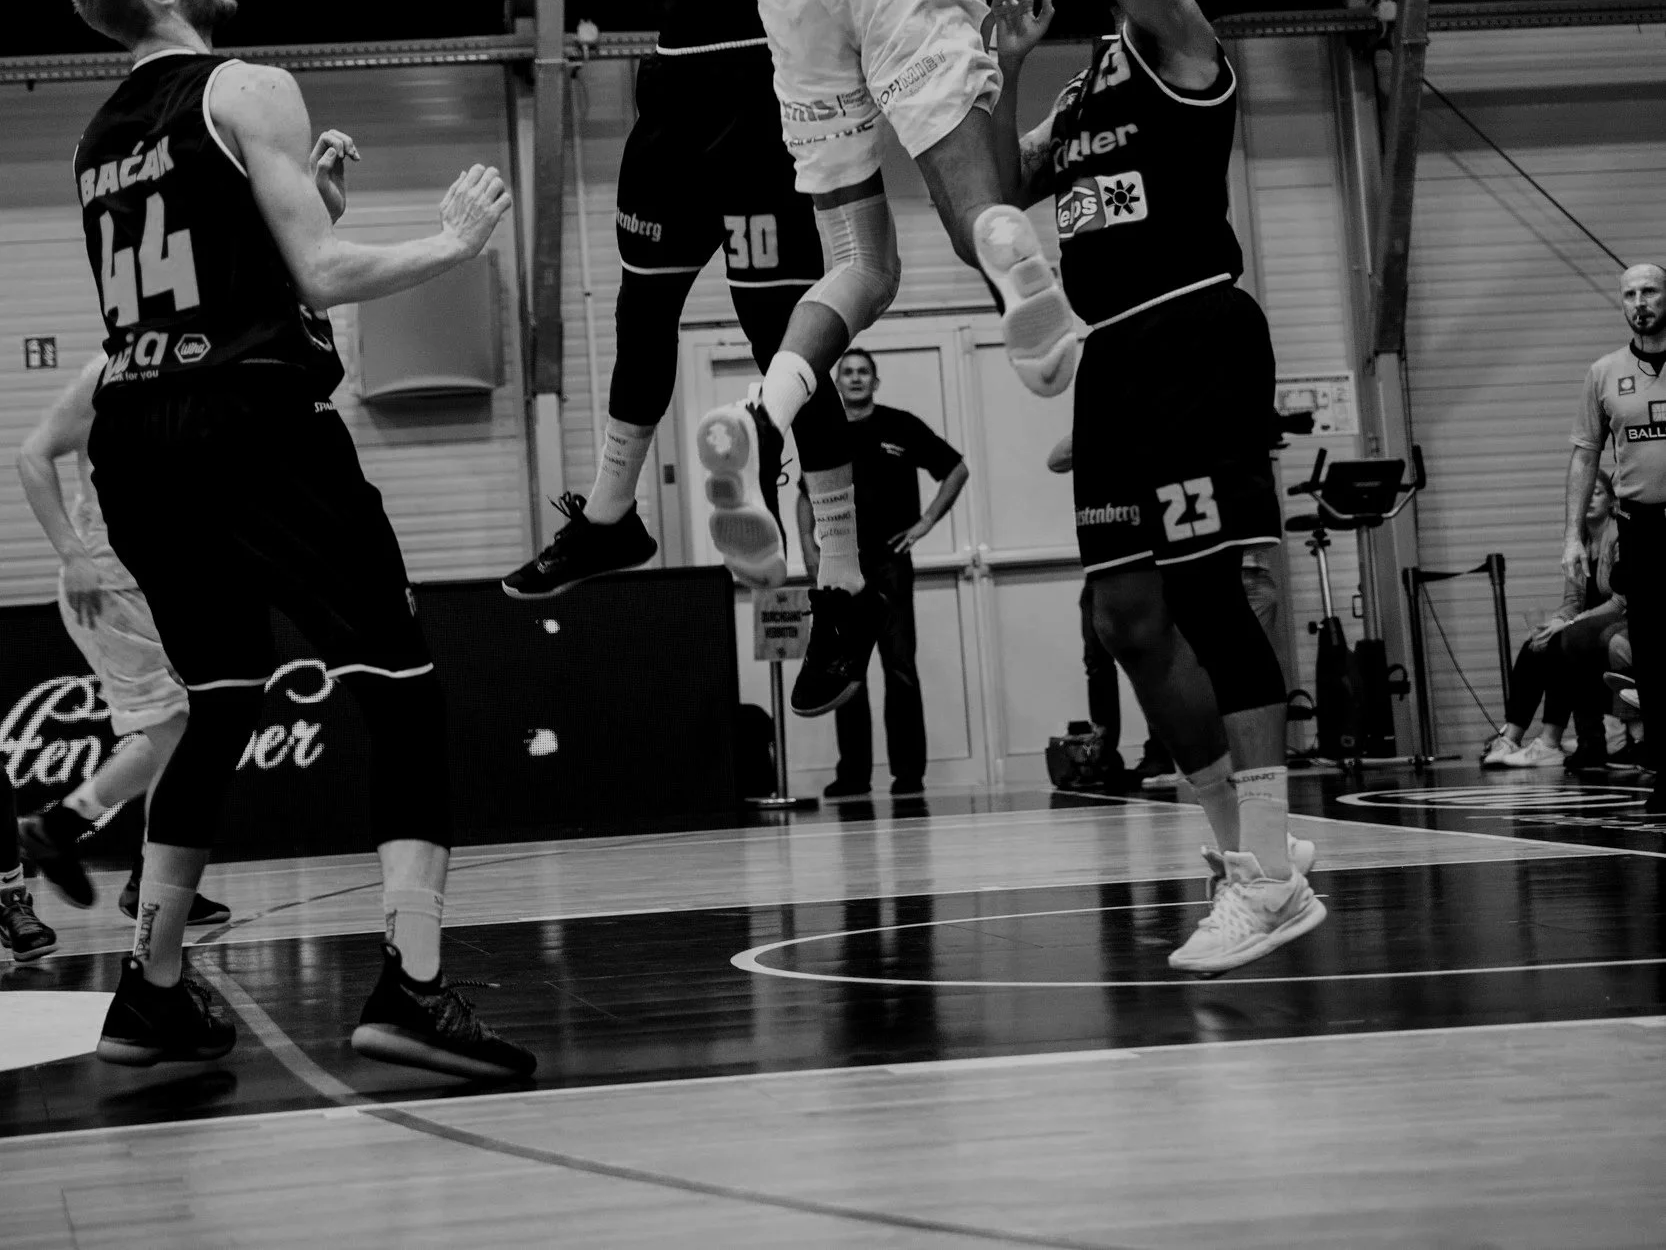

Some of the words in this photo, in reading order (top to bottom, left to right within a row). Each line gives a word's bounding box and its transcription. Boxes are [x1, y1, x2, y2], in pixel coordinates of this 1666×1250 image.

[99, 191, 201, 328] 44
[723, 213, 779, 269] 30
[140, 369, 159, 382] you
[1155, 476, 1222, 543] 23
